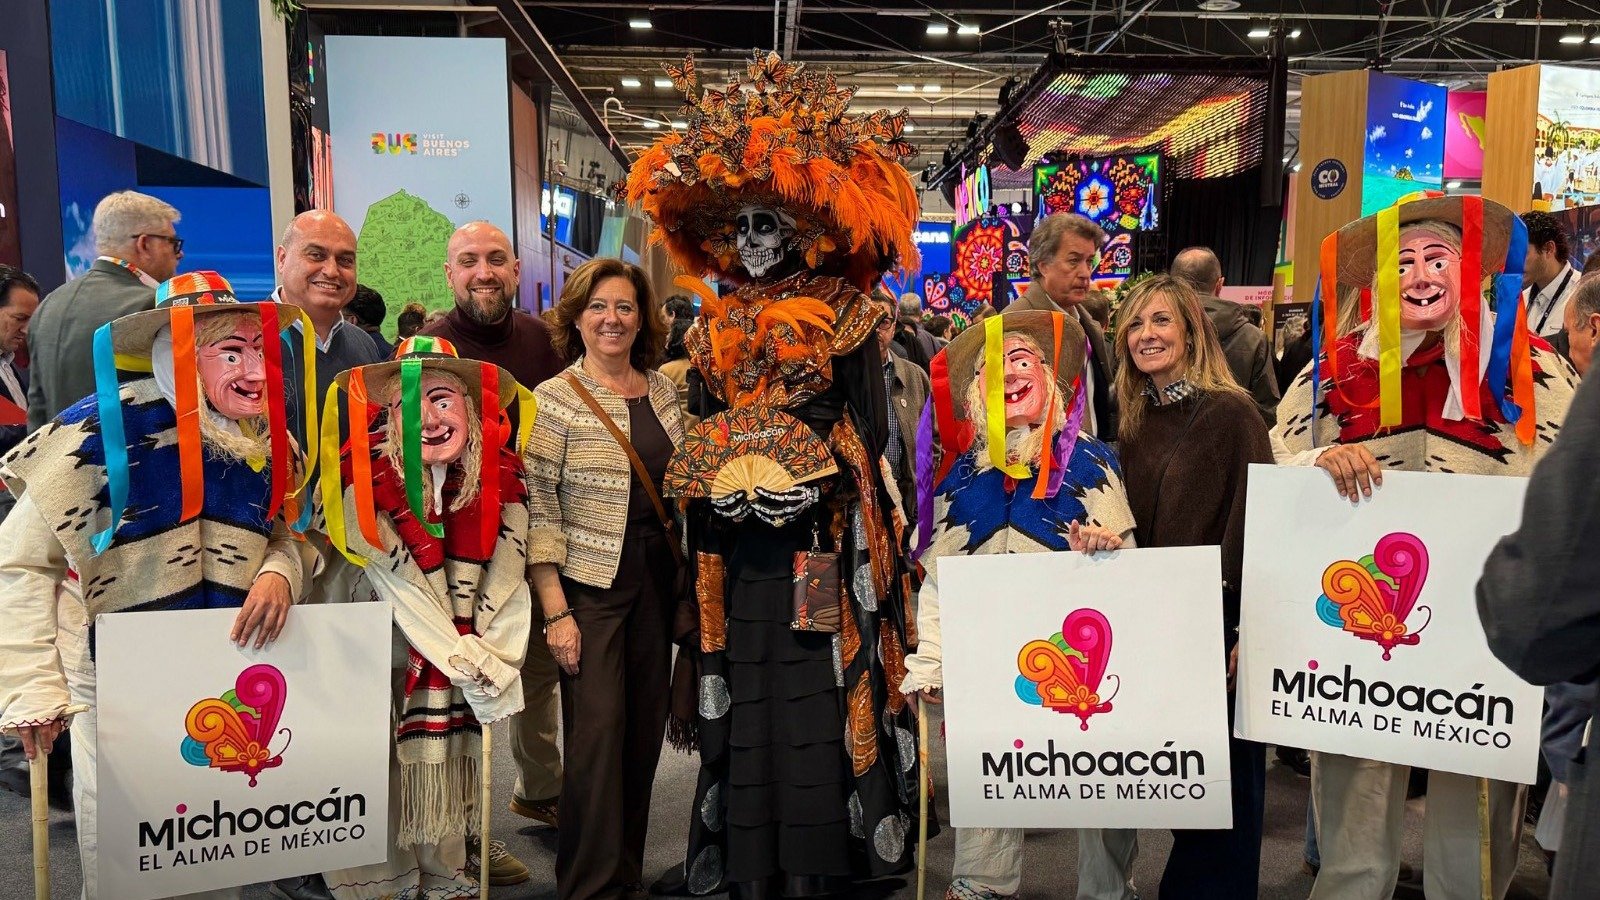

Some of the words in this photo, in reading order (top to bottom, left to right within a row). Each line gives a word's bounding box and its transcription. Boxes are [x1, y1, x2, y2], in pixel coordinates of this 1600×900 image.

[423, 140, 470, 148] BUENOS
[423, 148, 458, 156] AIRES
[733, 426, 784, 442] Michoacán
[1273, 659, 1514, 727] Michoacán
[1272, 700, 1293, 717] EL
[1302, 705, 1363, 728] ALMA
[1374, 714, 1402, 734] DE
[1414, 718, 1512, 749] MÉXICO
[982, 739, 1205, 783] Michoacán
[984, 783, 1005, 800] EL
[1013, 783, 1072, 800] ALMA
[1079, 783, 1106, 800] DE
[1117, 778, 1206, 800] MÉXICO
[139, 787, 366, 852] Michoacán
[139, 854, 163, 873] EL
[173, 843, 236, 868] ALMA
[245, 837, 271, 857] DE
[282, 823, 366, 851] MÉXICO
